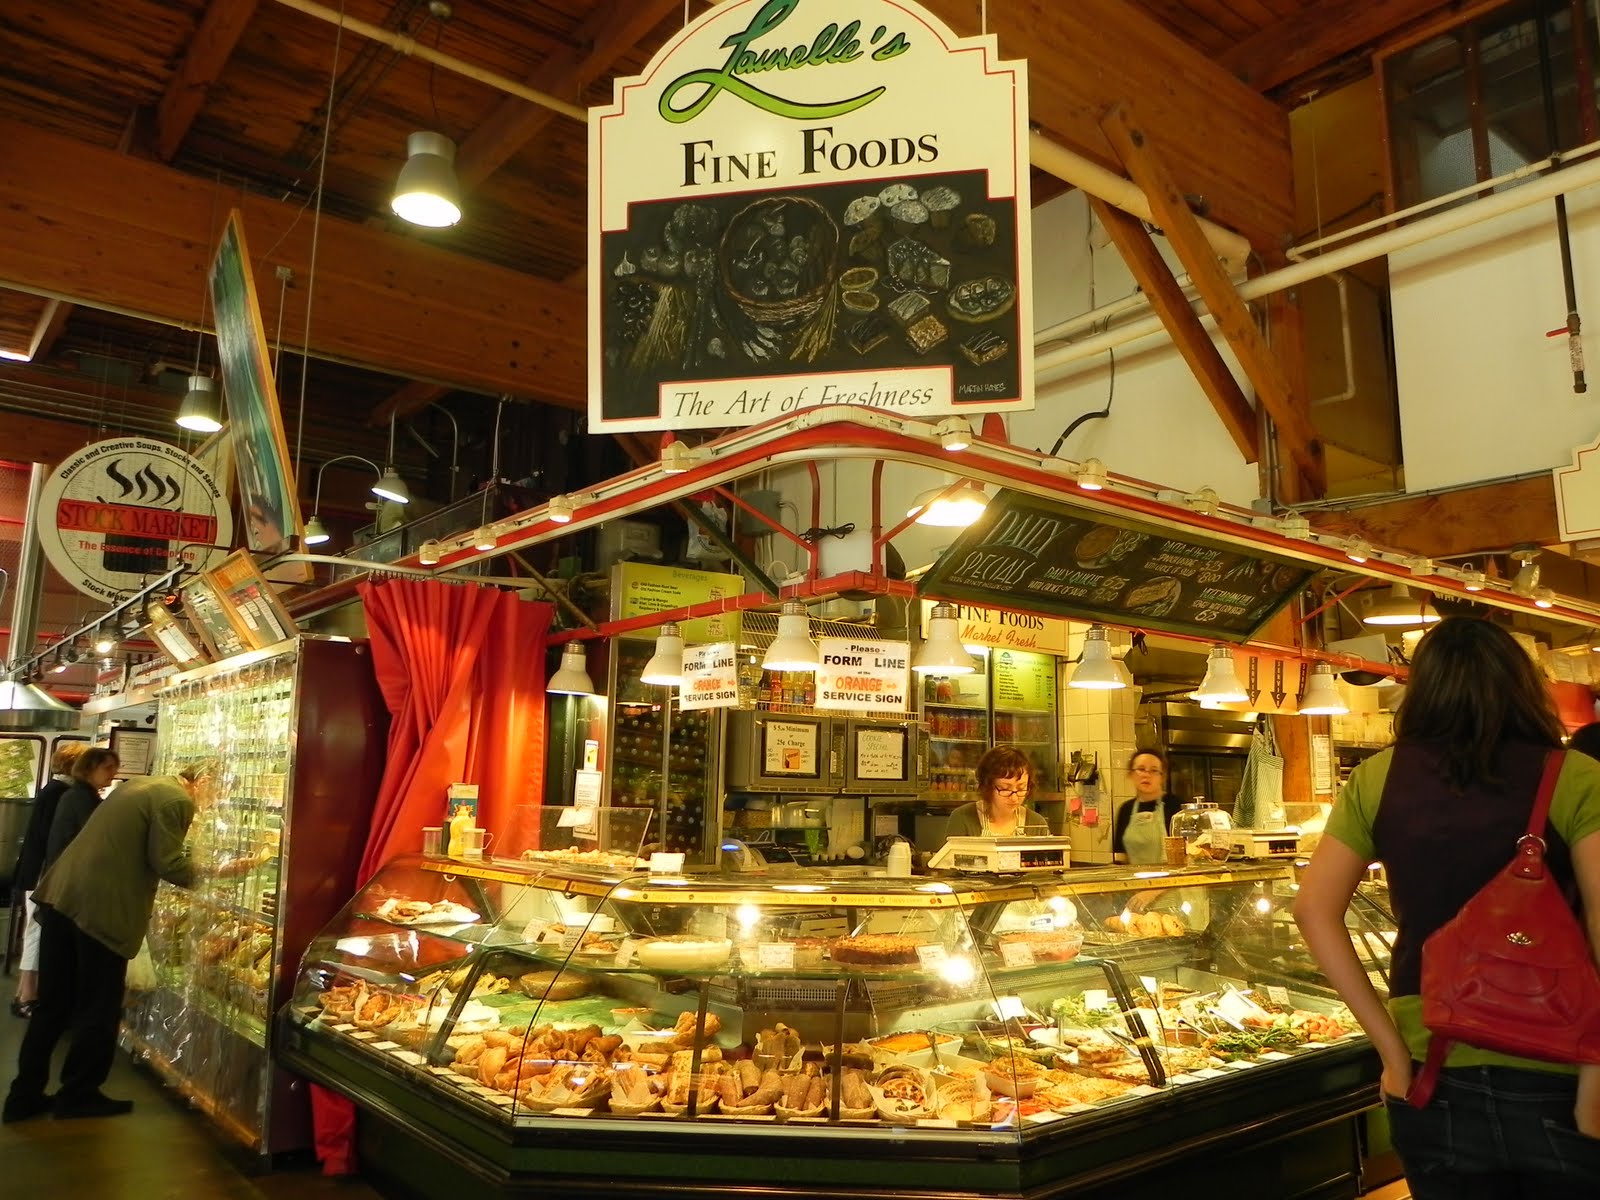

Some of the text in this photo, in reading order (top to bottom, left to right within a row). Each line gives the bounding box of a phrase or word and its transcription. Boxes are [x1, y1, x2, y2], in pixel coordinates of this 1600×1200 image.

[658, 0, 910, 123] Laurelle's
[680, 127, 939, 188] FINE FOODS
[674, 381, 934, 417] The Art of Freshness
[60, 457, 86, 480] Classic
[86, 448, 101, 460] and
[100, 441, 135, 454] Creative
[165, 447, 193, 467] Stocks
[190, 463, 204, 475] and
[202, 473, 221, 499] Sauces
[60, 502, 215, 539] STOCK MARKET
[977, 510, 1077, 559] DAILY
[78, 540, 97, 550] The
[672, 570, 708, 581] Beverages
[954, 551, 1037, 586] SPECIALS
[1044, 566, 1074, 582] DAILY
[82, 579, 107, 596] Stock
[957, 605, 1044, 631] FINE FOODS
[960, 624, 1037, 649] Market Fresh
[850, 645, 881, 653] Please
[684, 658, 734, 672] FORM LINE
[824, 655, 906, 669] FORM LINE
[836, 676, 883, 692] ORANGE
[716, 690, 736, 700] SIGN
[823, 691, 902, 704] SERVICE SIGN
